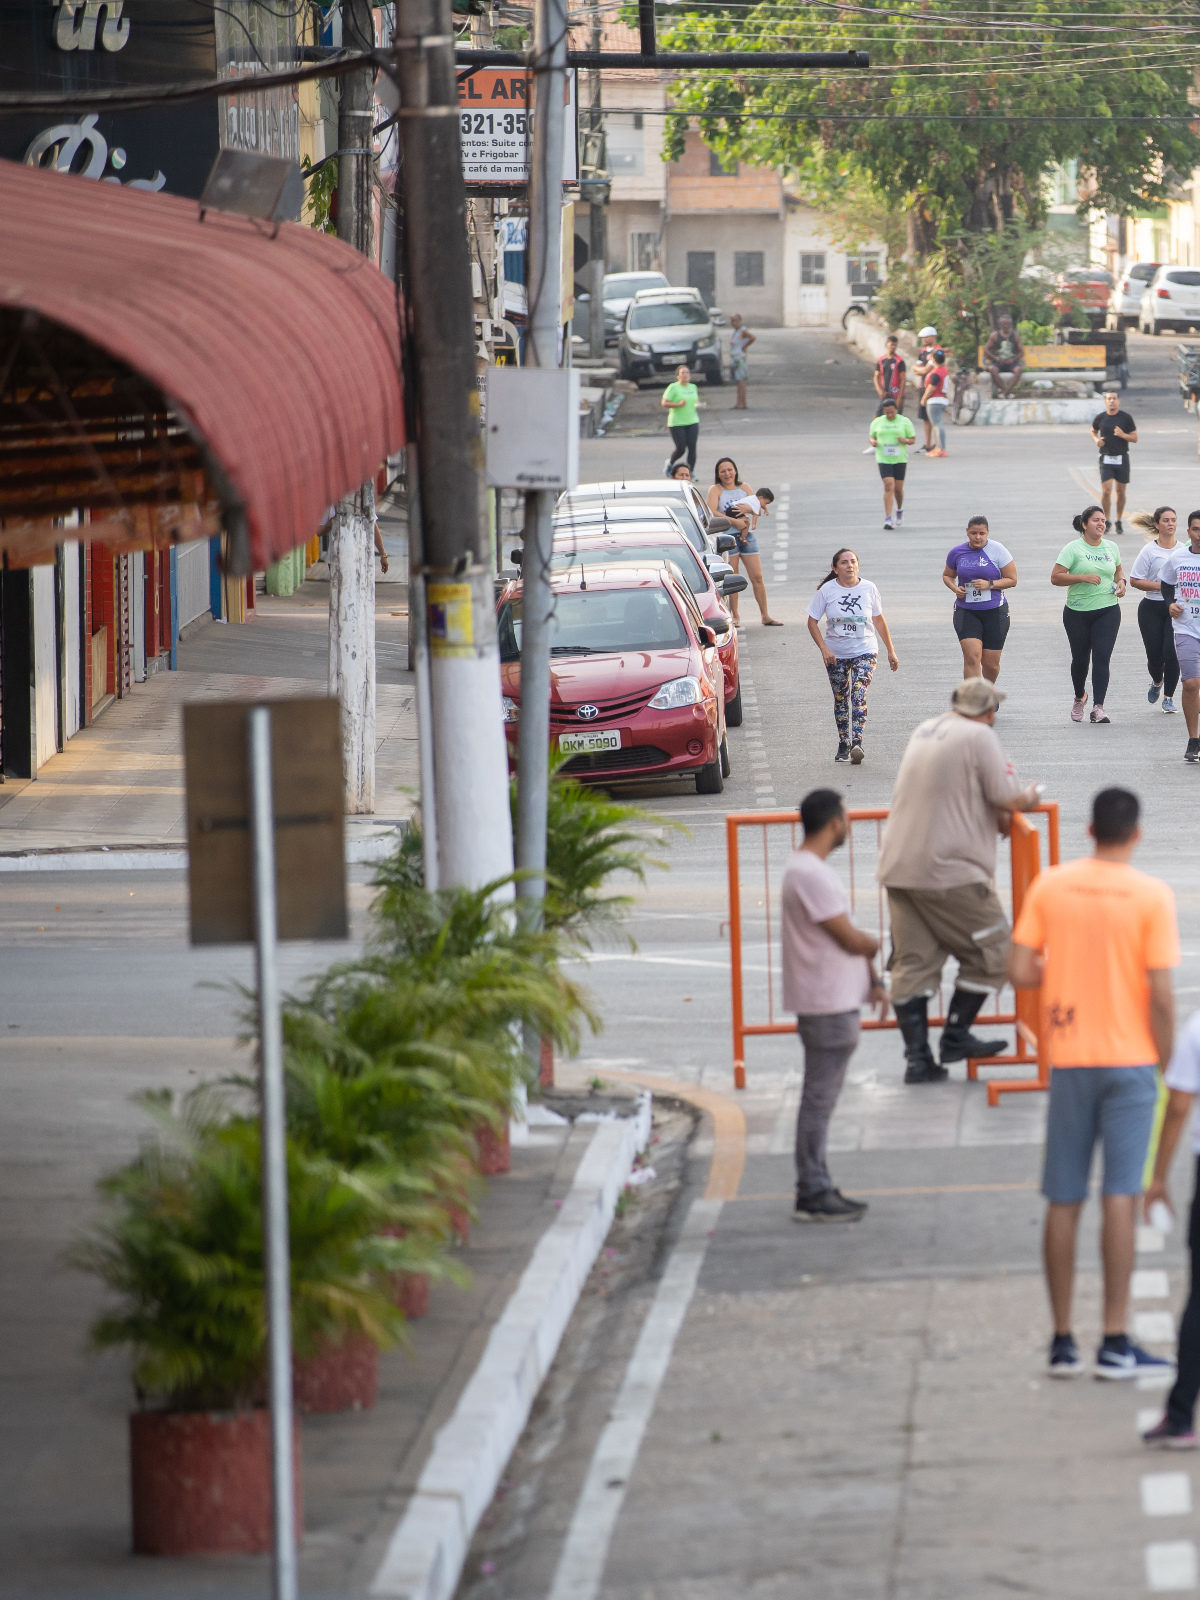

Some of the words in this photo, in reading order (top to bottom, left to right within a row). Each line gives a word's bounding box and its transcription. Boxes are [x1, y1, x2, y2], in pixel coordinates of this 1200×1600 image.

[491, 139, 516, 147] Suite
[479, 150, 519, 160] Frigobar
[468, 164, 487, 173] café
[490, 164, 502, 173] da
[504, 164, 529, 173] manh
[842, 623, 857, 632] 108
